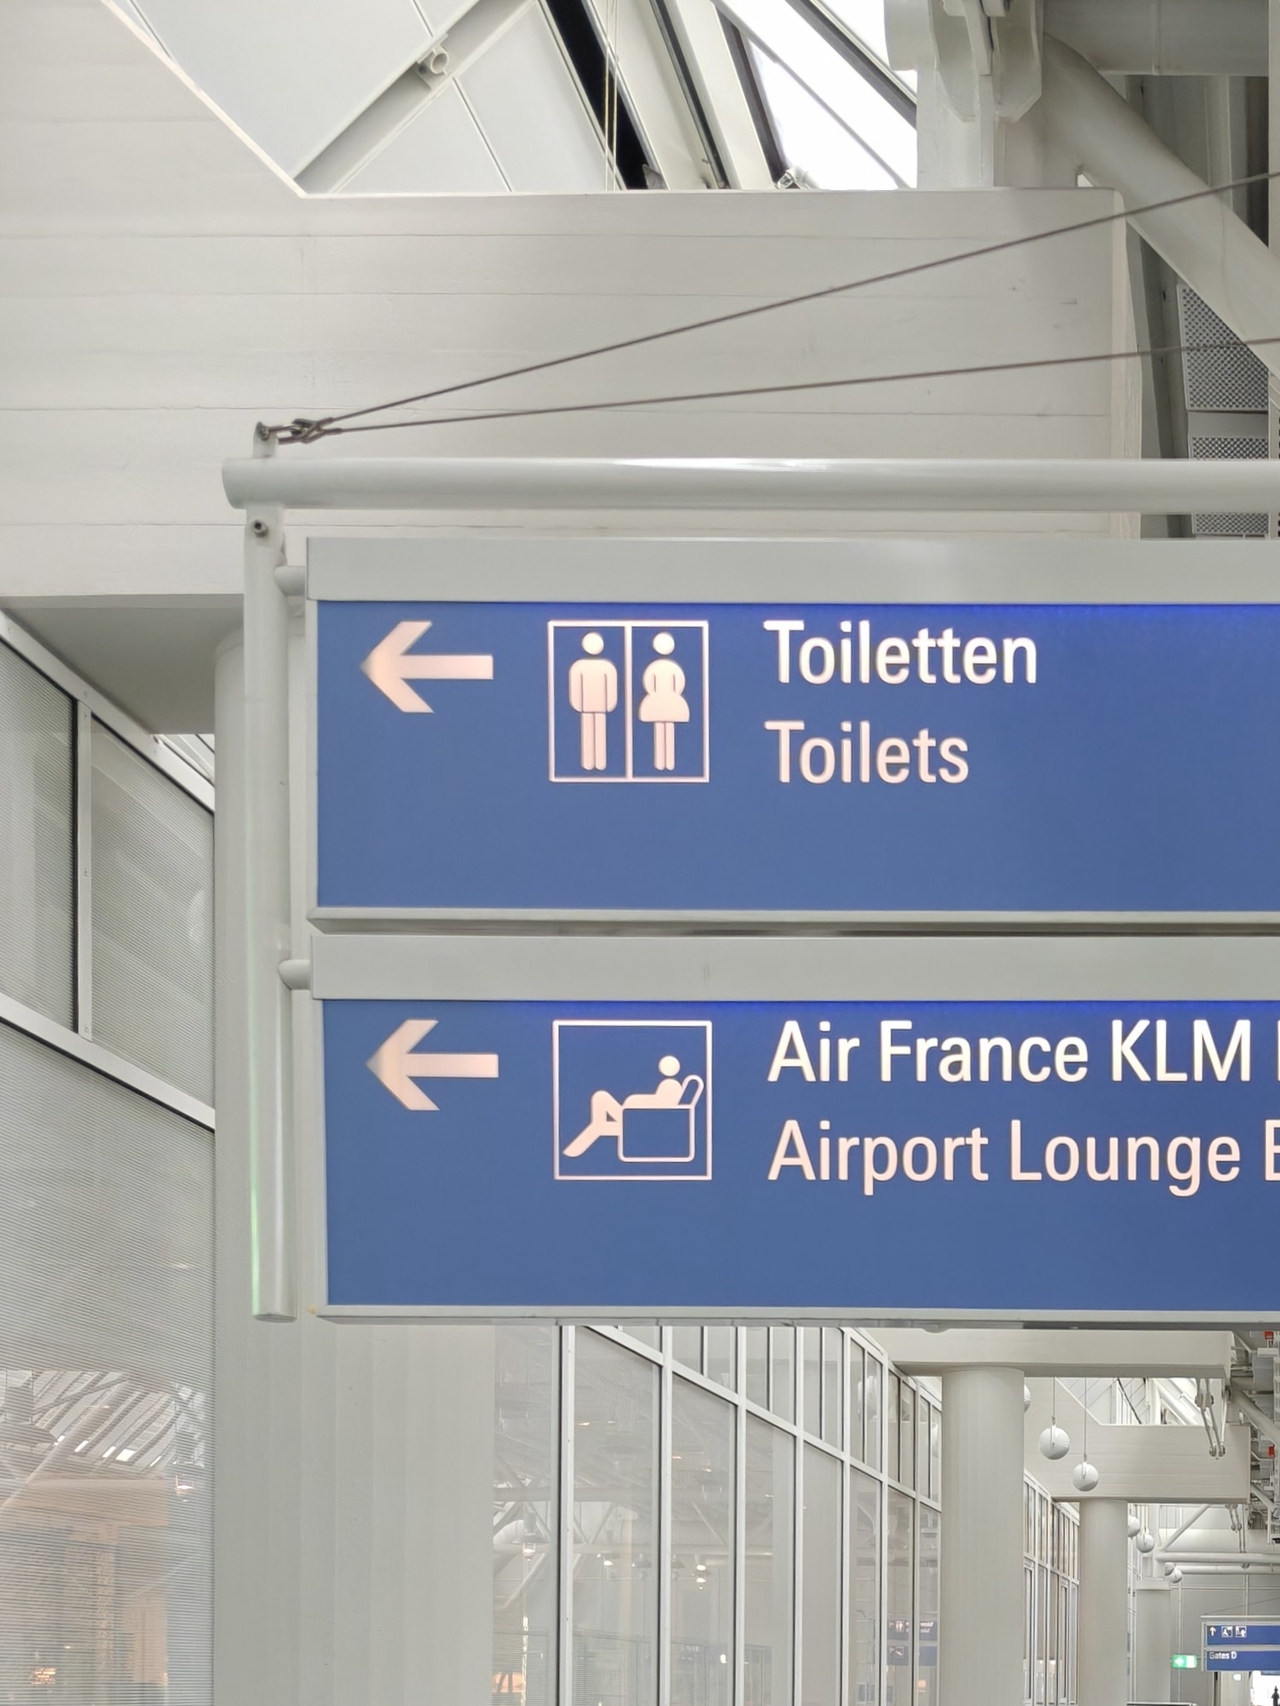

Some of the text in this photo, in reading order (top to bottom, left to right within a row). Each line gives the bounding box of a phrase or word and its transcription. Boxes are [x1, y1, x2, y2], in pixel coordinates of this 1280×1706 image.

[763, 619, 1038, 685] Toiletten
[763, 719, 970, 784] Toilets
[767, 1018, 861, 1083] Air
[879, 1019, 1089, 1083] France
[1110, 1019, 1253, 1082] KLM
[767, 1118, 990, 1196] Airport
[1009, 1119, 1241, 1197] Lounge
[1209, 1650, 1237, 1659] Gates D
